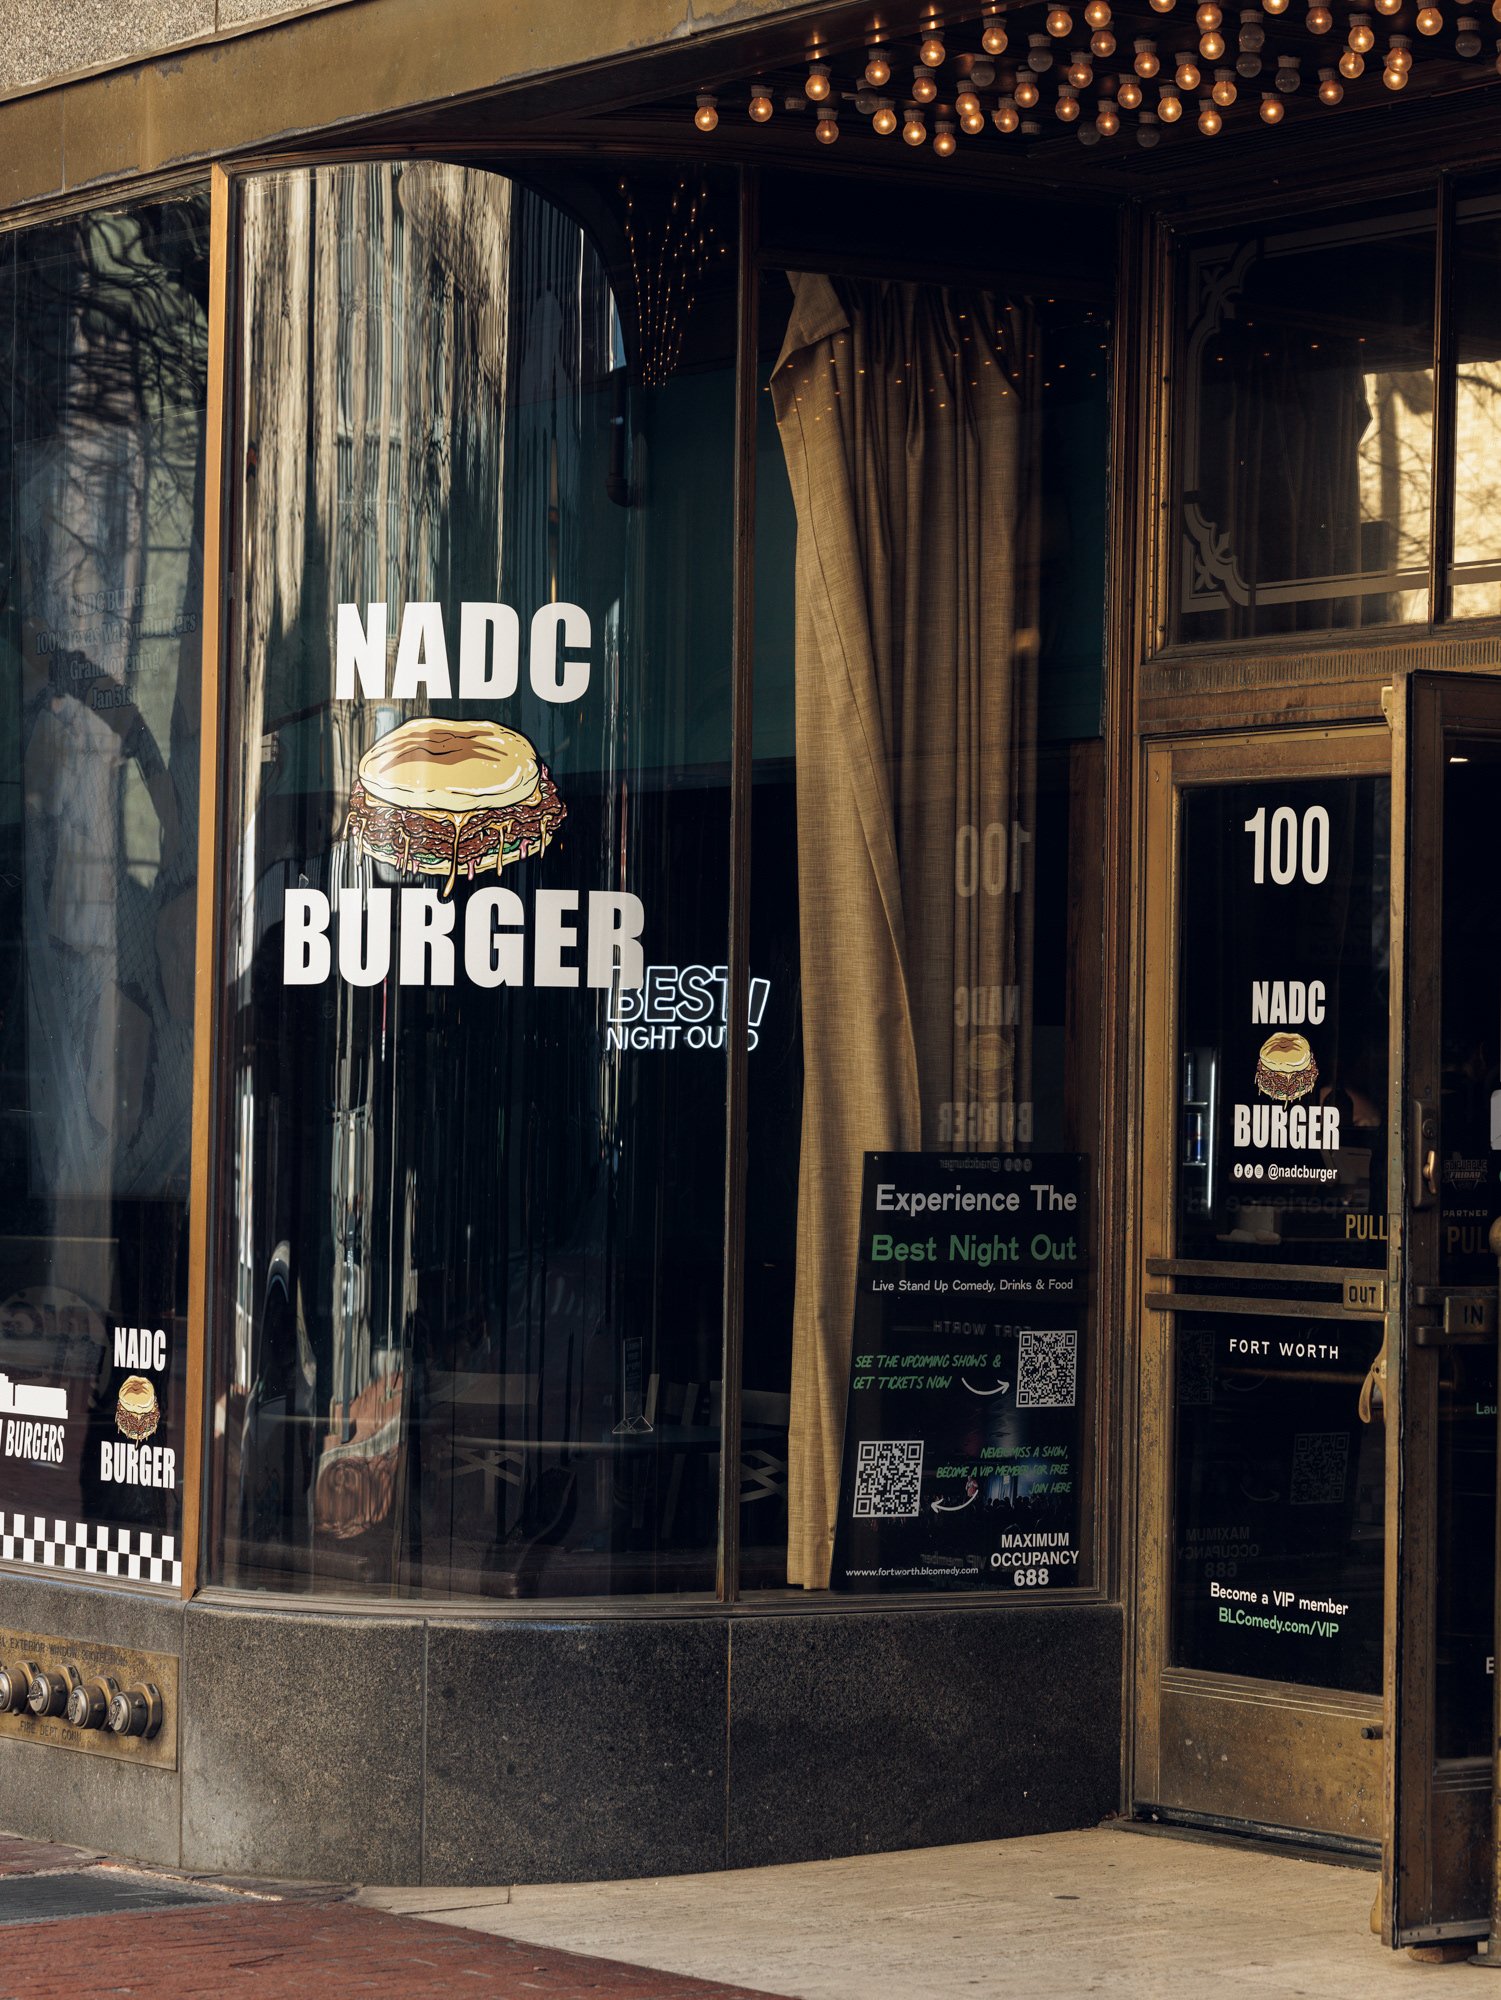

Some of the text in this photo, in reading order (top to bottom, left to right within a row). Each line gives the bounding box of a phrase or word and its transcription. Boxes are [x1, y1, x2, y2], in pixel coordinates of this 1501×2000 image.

[107, 584, 158, 611] BURGER
[37, 613, 197, 655] 100% Texas Wagyu Burgers
[336, 602, 592, 703] NADC
[70, 654, 108, 681] Grand
[92, 687, 112, 710] Jan
[1245, 806, 1330, 885] 100
[283, 886, 645, 988] BURGER
[1252, 981, 1325, 1024] NADC
[606, 1026, 728, 1050] NIGHT OU
[1233, 1104, 1339, 1150] BURGER
[1268, 1164, 1338, 1182] @nadcburger
[876, 1184, 1077, 1217] Experience The
[1443, 1209, 1488, 1218] PARTNER
[1345, 1214, 1388, 1240] PULL
[871, 1233, 1077, 1267] Best Night Out
[1447, 1226, 1490, 1254] PUL
[872, 1278, 1073, 1293] Live Stand Up Comedy, Drinks & Food
[1348, 1286, 1376, 1303] OUT
[1464, 1305, 1484, 1325] IN
[113, 1327, 167, 1371] NADC
[855, 1354, 1002, 1367] SEE THE UPCOMING SHOWS &
[1229, 1338, 1339, 1360] FORT WORTH
[853, 1375, 953, 1389] GET TICKETS NOW
[5, 1419, 65, 1463] BURGERS
[1033, 1446, 1040, 1457] A
[1042, 1446, 1068, 1459] SHOW,
[101, 1440, 176, 1489] BURGER
[936, 1466, 969, 1478] BECOME
[970, 1466, 978, 1477] A
[980, 1466, 993, 1476] VIP
[995, 1464, 1028, 1476] MEMBER
[1050, 1463, 1070, 1475] FREE
[1029, 1482, 1072, 1494] JOIN HERE
[1001, 1532, 1070, 1549] MAXIMUM
[990, 1550, 1080, 1568] OCCUPANCY
[1013, 1568, 1050, 1587] 688
[1210, 1582, 1349, 1616] Become a VIP member
[1218, 1607, 1340, 1638] BLComedy.com/VIP
[10, 1637, 45, 1653] EXTERIOR
[49, 1643, 77, 1658] WINDOW
[20, 1720, 36, 1734] FIRE
[40, 1724, 58, 1737] DEPT
